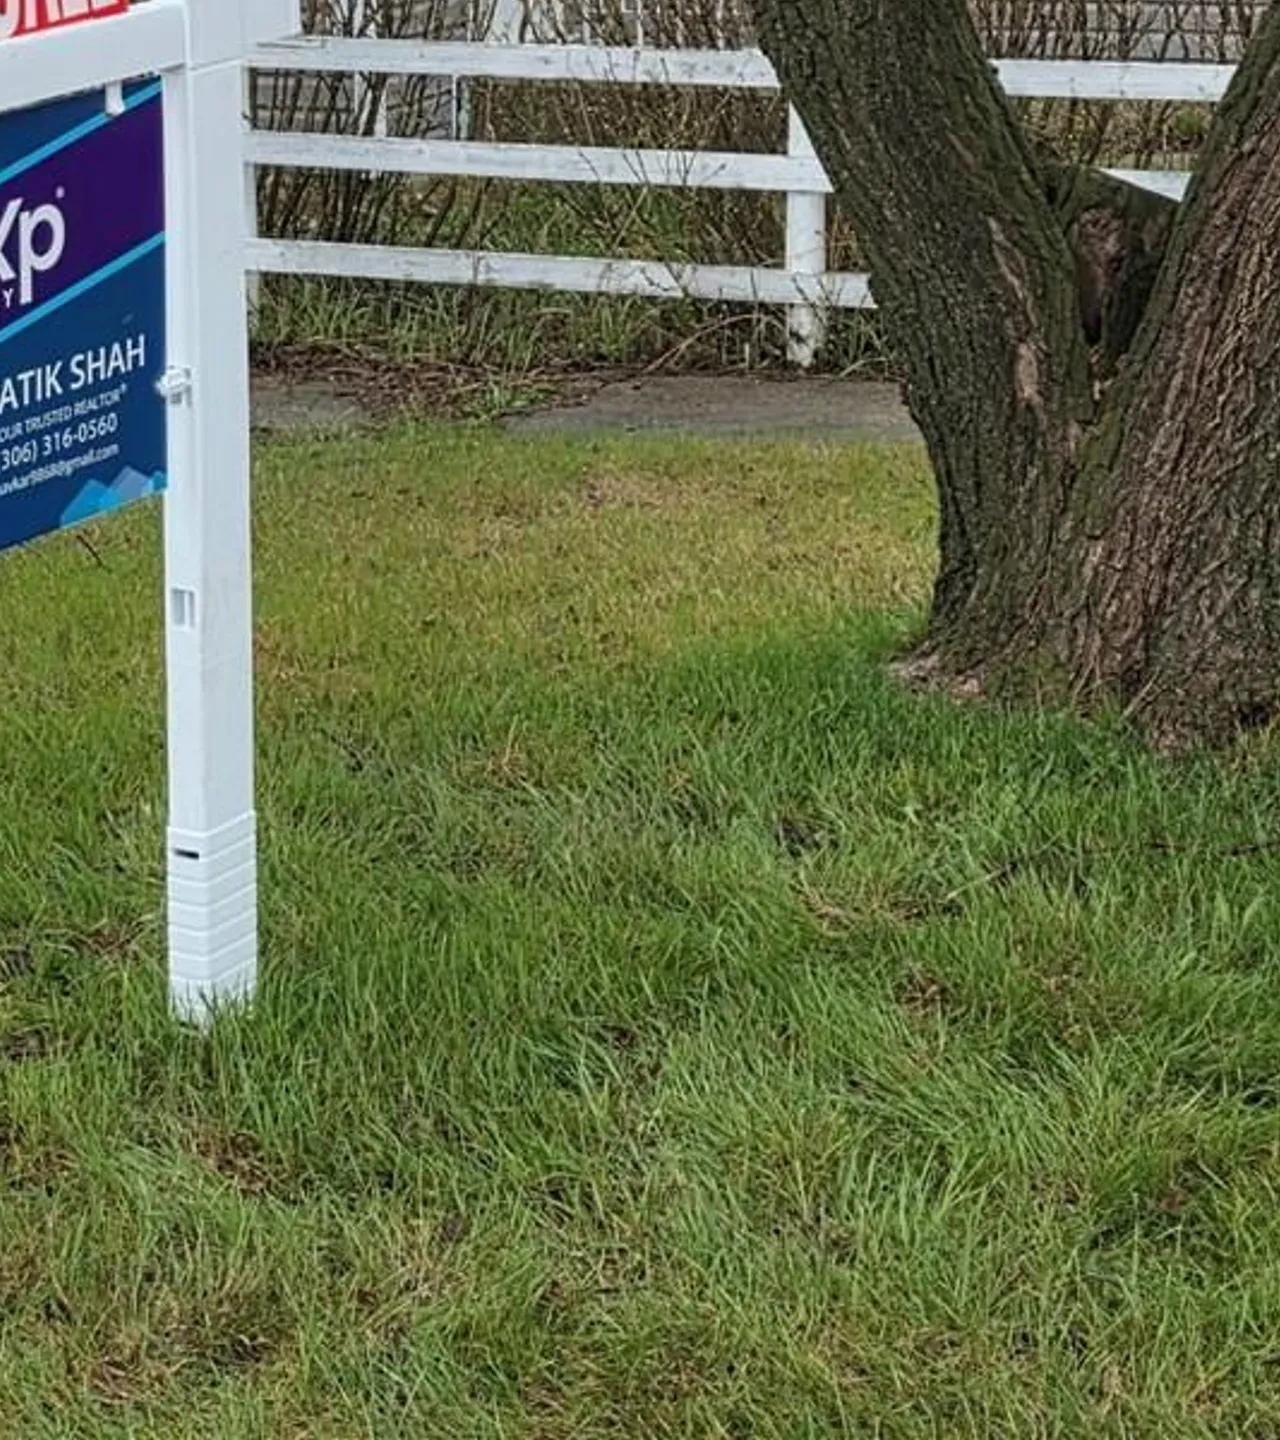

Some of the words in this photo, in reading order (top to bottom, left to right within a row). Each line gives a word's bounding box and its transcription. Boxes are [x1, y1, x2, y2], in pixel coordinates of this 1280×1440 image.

[69, 333, 146, 390] SHAH
[25, 405, 72, 433] TRUSTED
[42, 412, 119, 456] 316-0560
